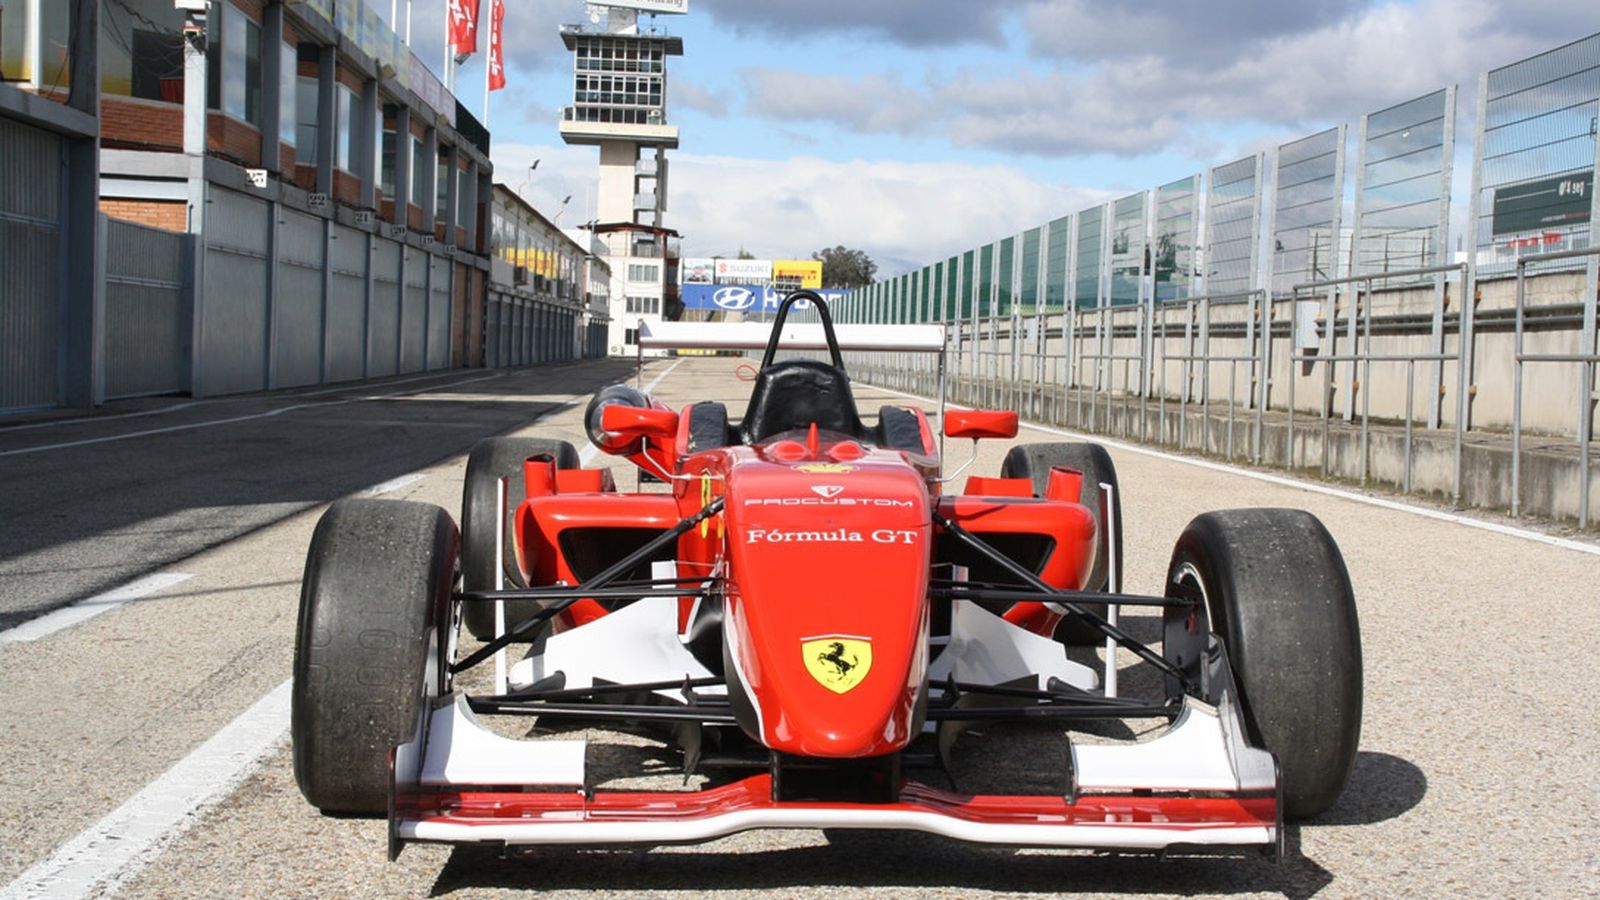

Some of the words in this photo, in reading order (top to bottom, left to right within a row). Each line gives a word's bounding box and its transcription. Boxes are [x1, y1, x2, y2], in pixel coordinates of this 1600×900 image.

[309, 194, 325, 206] 22
[356, 212, 369, 223] 21
[729, 264, 769, 273] SUZUKI
[744, 497, 913, 507] PROCUSTOM
[746, 528, 865, 544] Fórmula
[871, 529, 918, 545] GT
